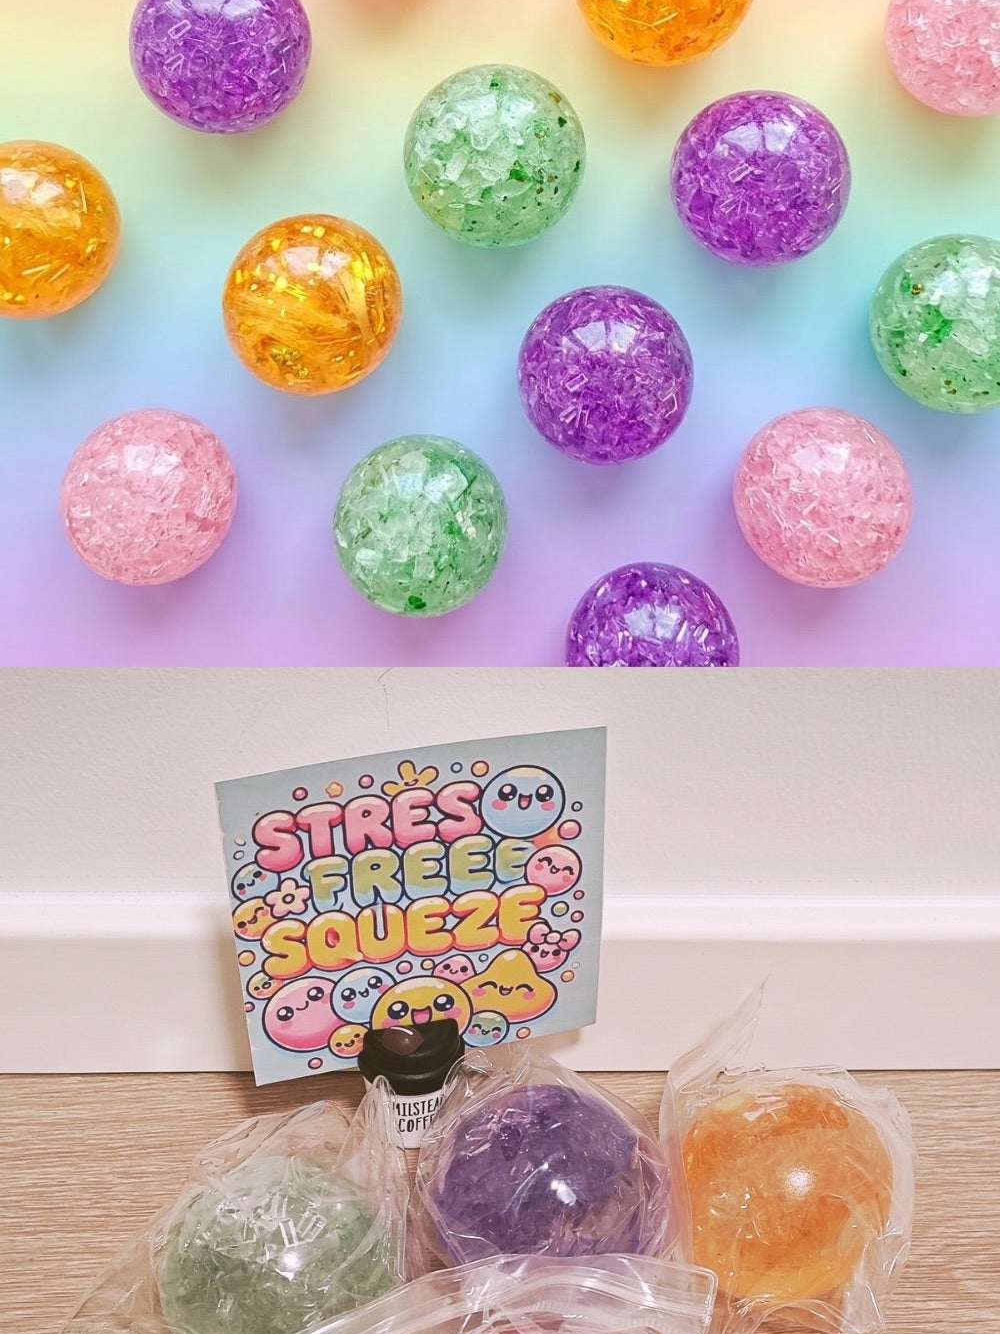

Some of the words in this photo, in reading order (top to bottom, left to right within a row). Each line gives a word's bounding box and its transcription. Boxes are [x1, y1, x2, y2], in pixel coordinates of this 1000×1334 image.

[252, 780, 484, 873] STRES
[260, 884, 547, 980] SQUEZE
[392, 1093, 444, 1117] MILSTEA
